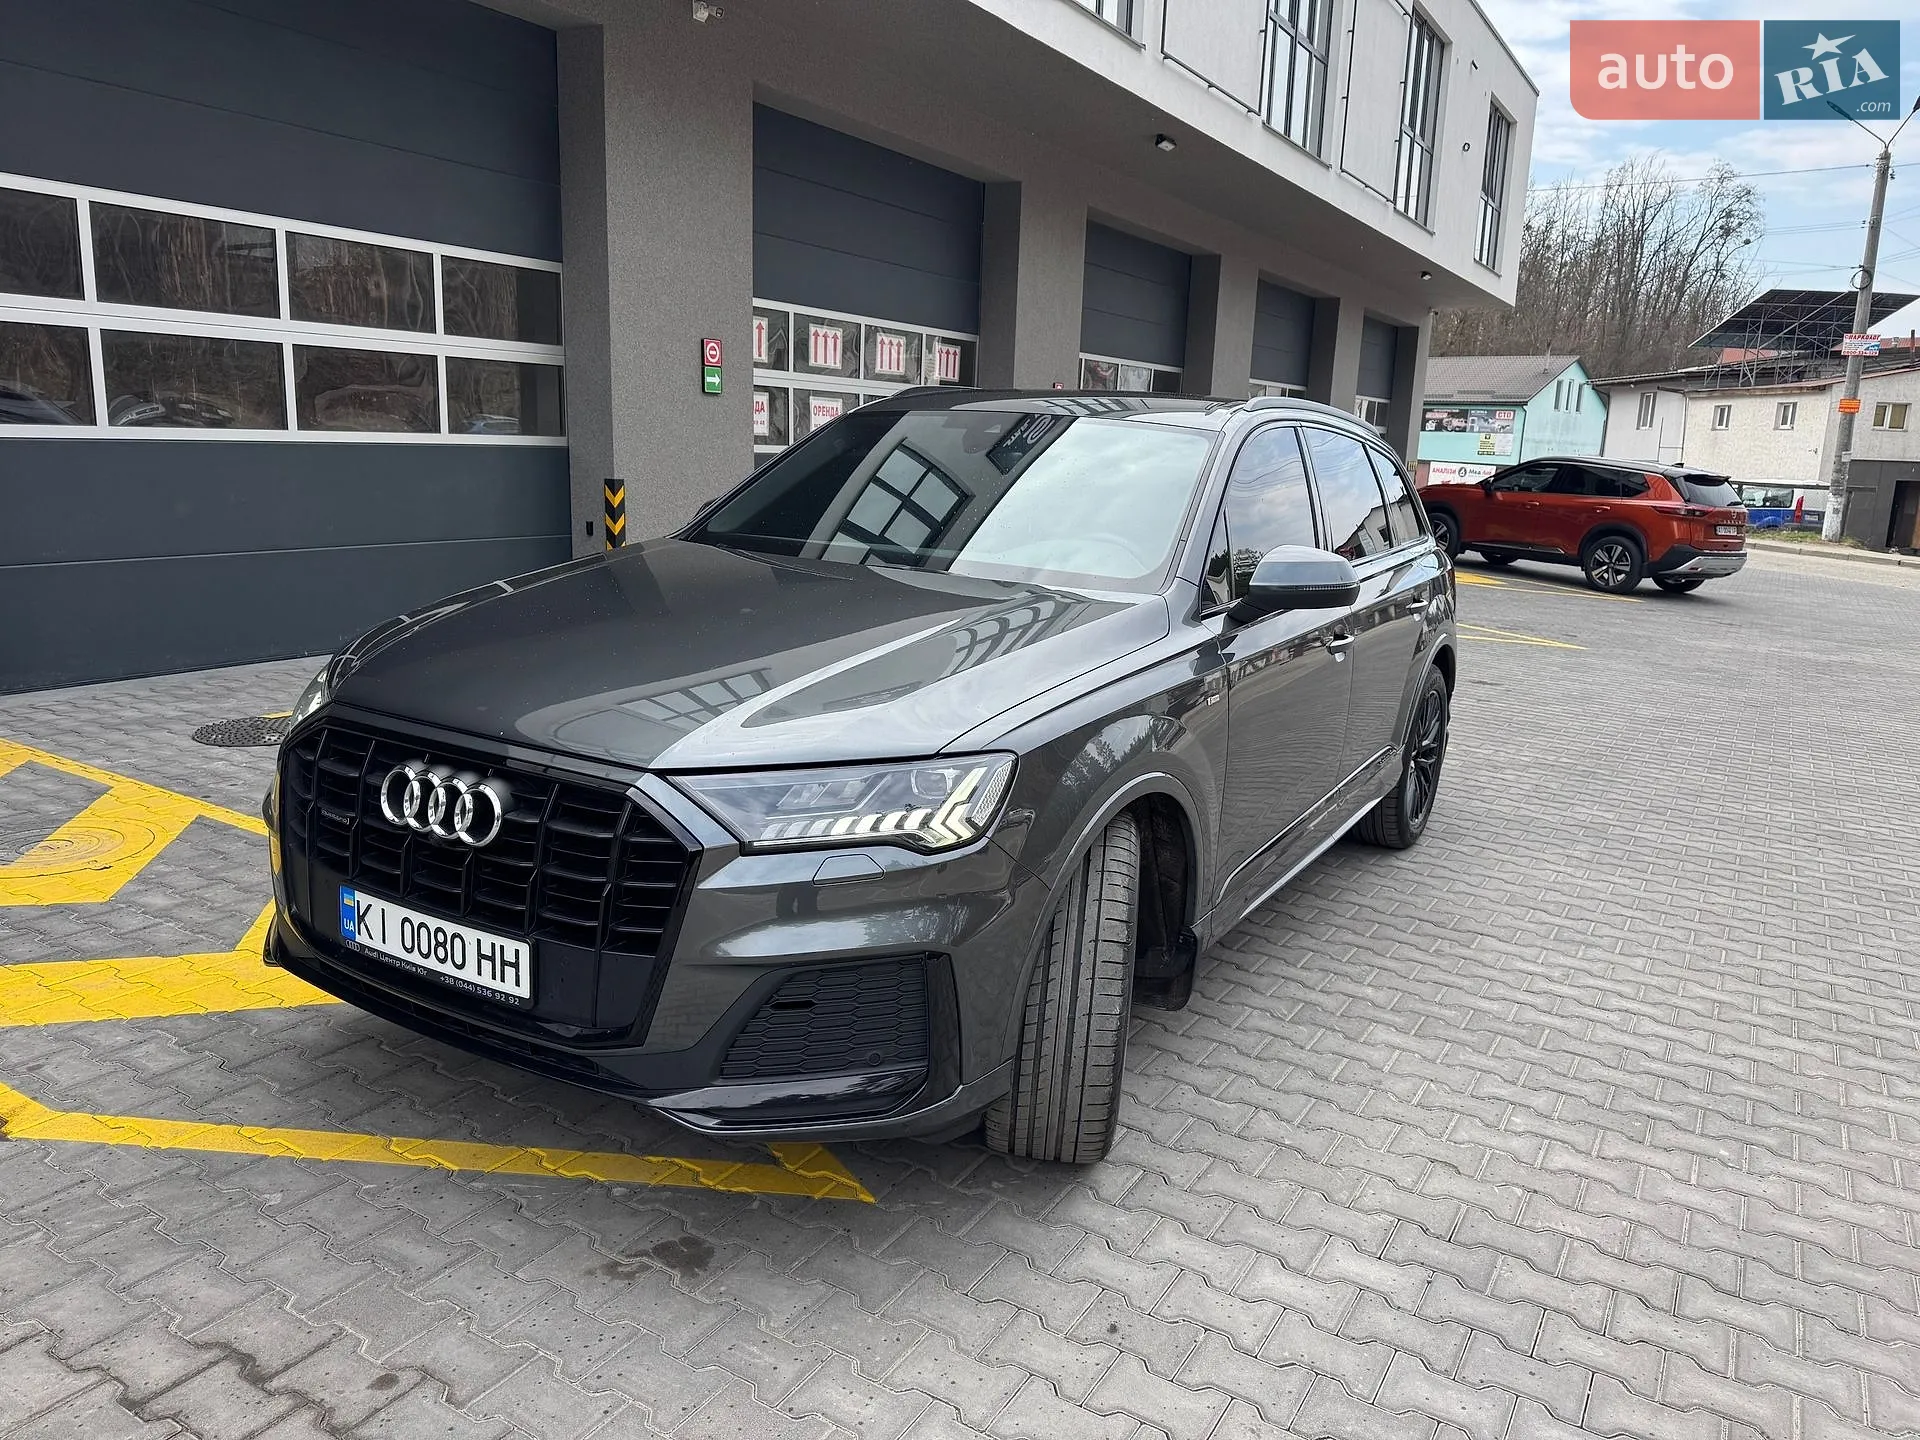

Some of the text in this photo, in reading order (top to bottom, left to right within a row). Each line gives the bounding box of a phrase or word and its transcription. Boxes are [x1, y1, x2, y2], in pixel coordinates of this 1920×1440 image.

[813, 404, 839, 417] ОРЕНДА
[343, 917, 355, 933] UA
[356, 899, 521, 988] KI 0080 HH
[364, 947, 379, 958] Audi
[379, 953, 400, 967] Центр
[440, 975, 520, 1006] +38 (044) 536 92 92
